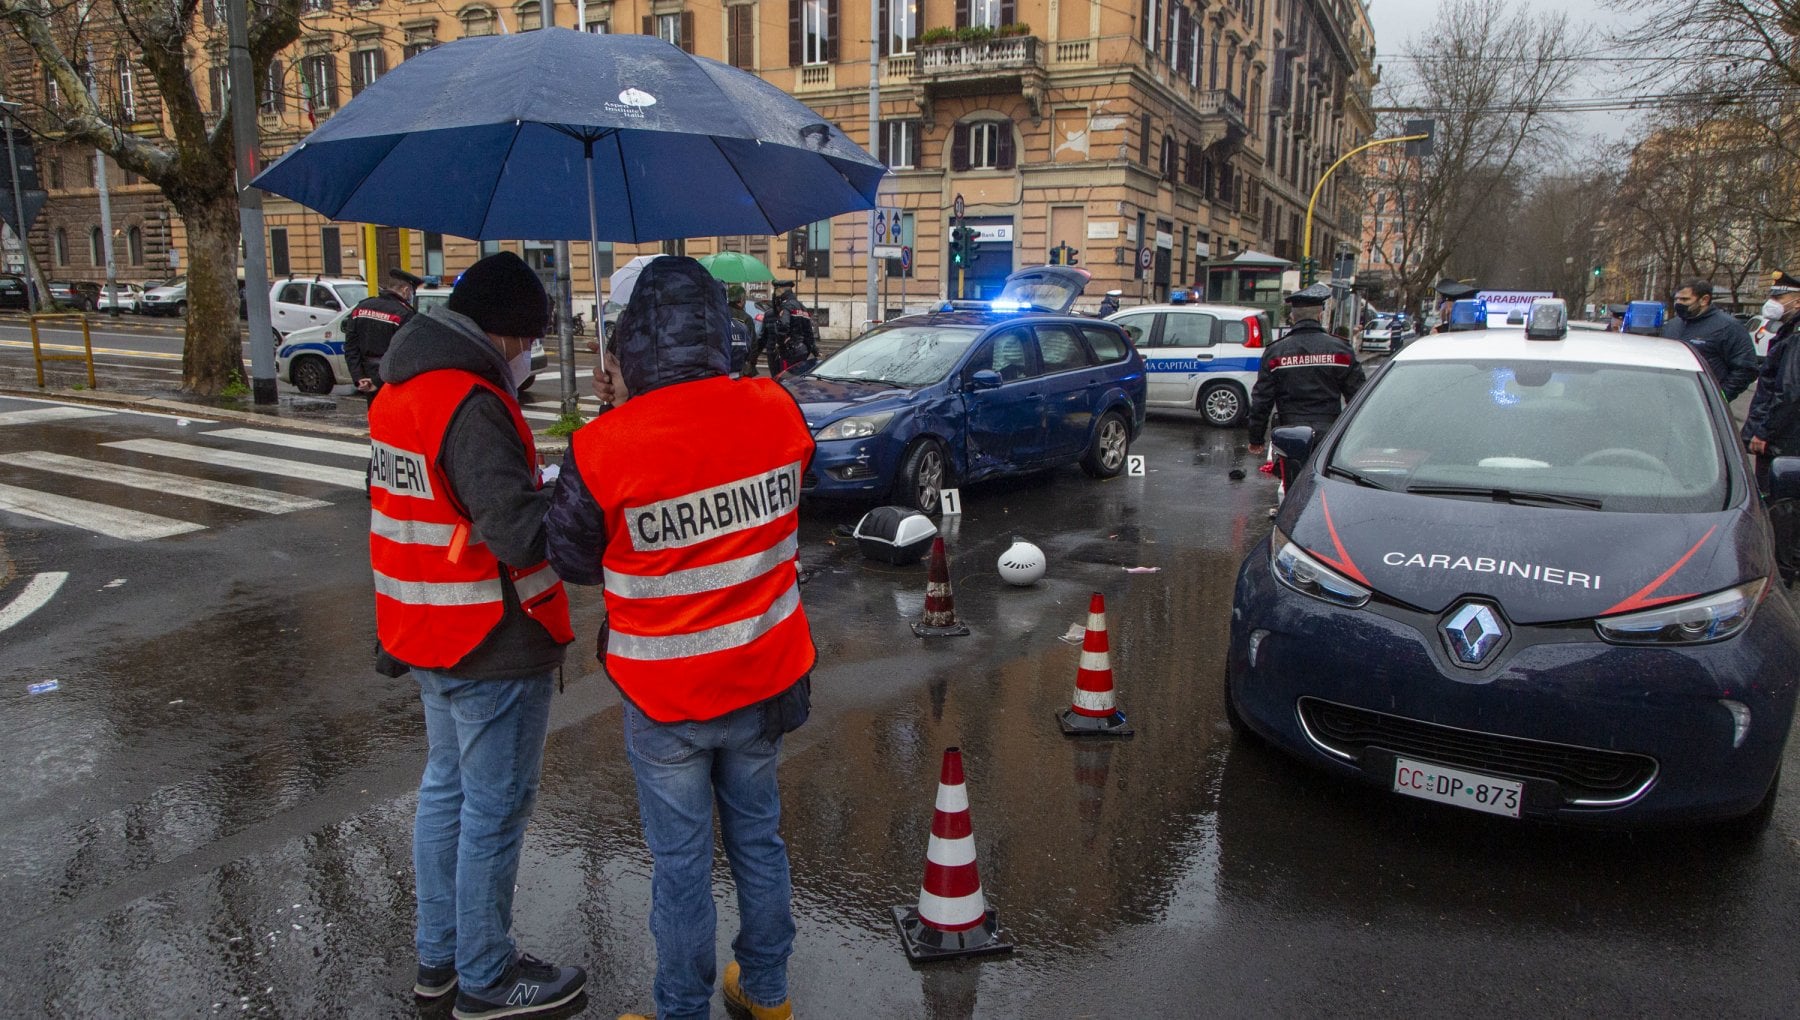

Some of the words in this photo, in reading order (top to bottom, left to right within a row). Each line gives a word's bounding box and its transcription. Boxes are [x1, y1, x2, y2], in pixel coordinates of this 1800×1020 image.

[1158, 361, 1198, 370] CAPITALE
[1281, 354, 1335, 366] CARABINIERI
[1130, 457, 1142, 474] 2
[637, 470, 796, 544] CARABINIERI
[944, 491, 955, 512] 1
[1383, 552, 1601, 590] CARABINIERI
[1398, 767, 1424, 789] CC
[1436, 775, 1464, 797] DP
[1475, 784, 1519, 809] 873
[506, 983, 539, 1007] N
